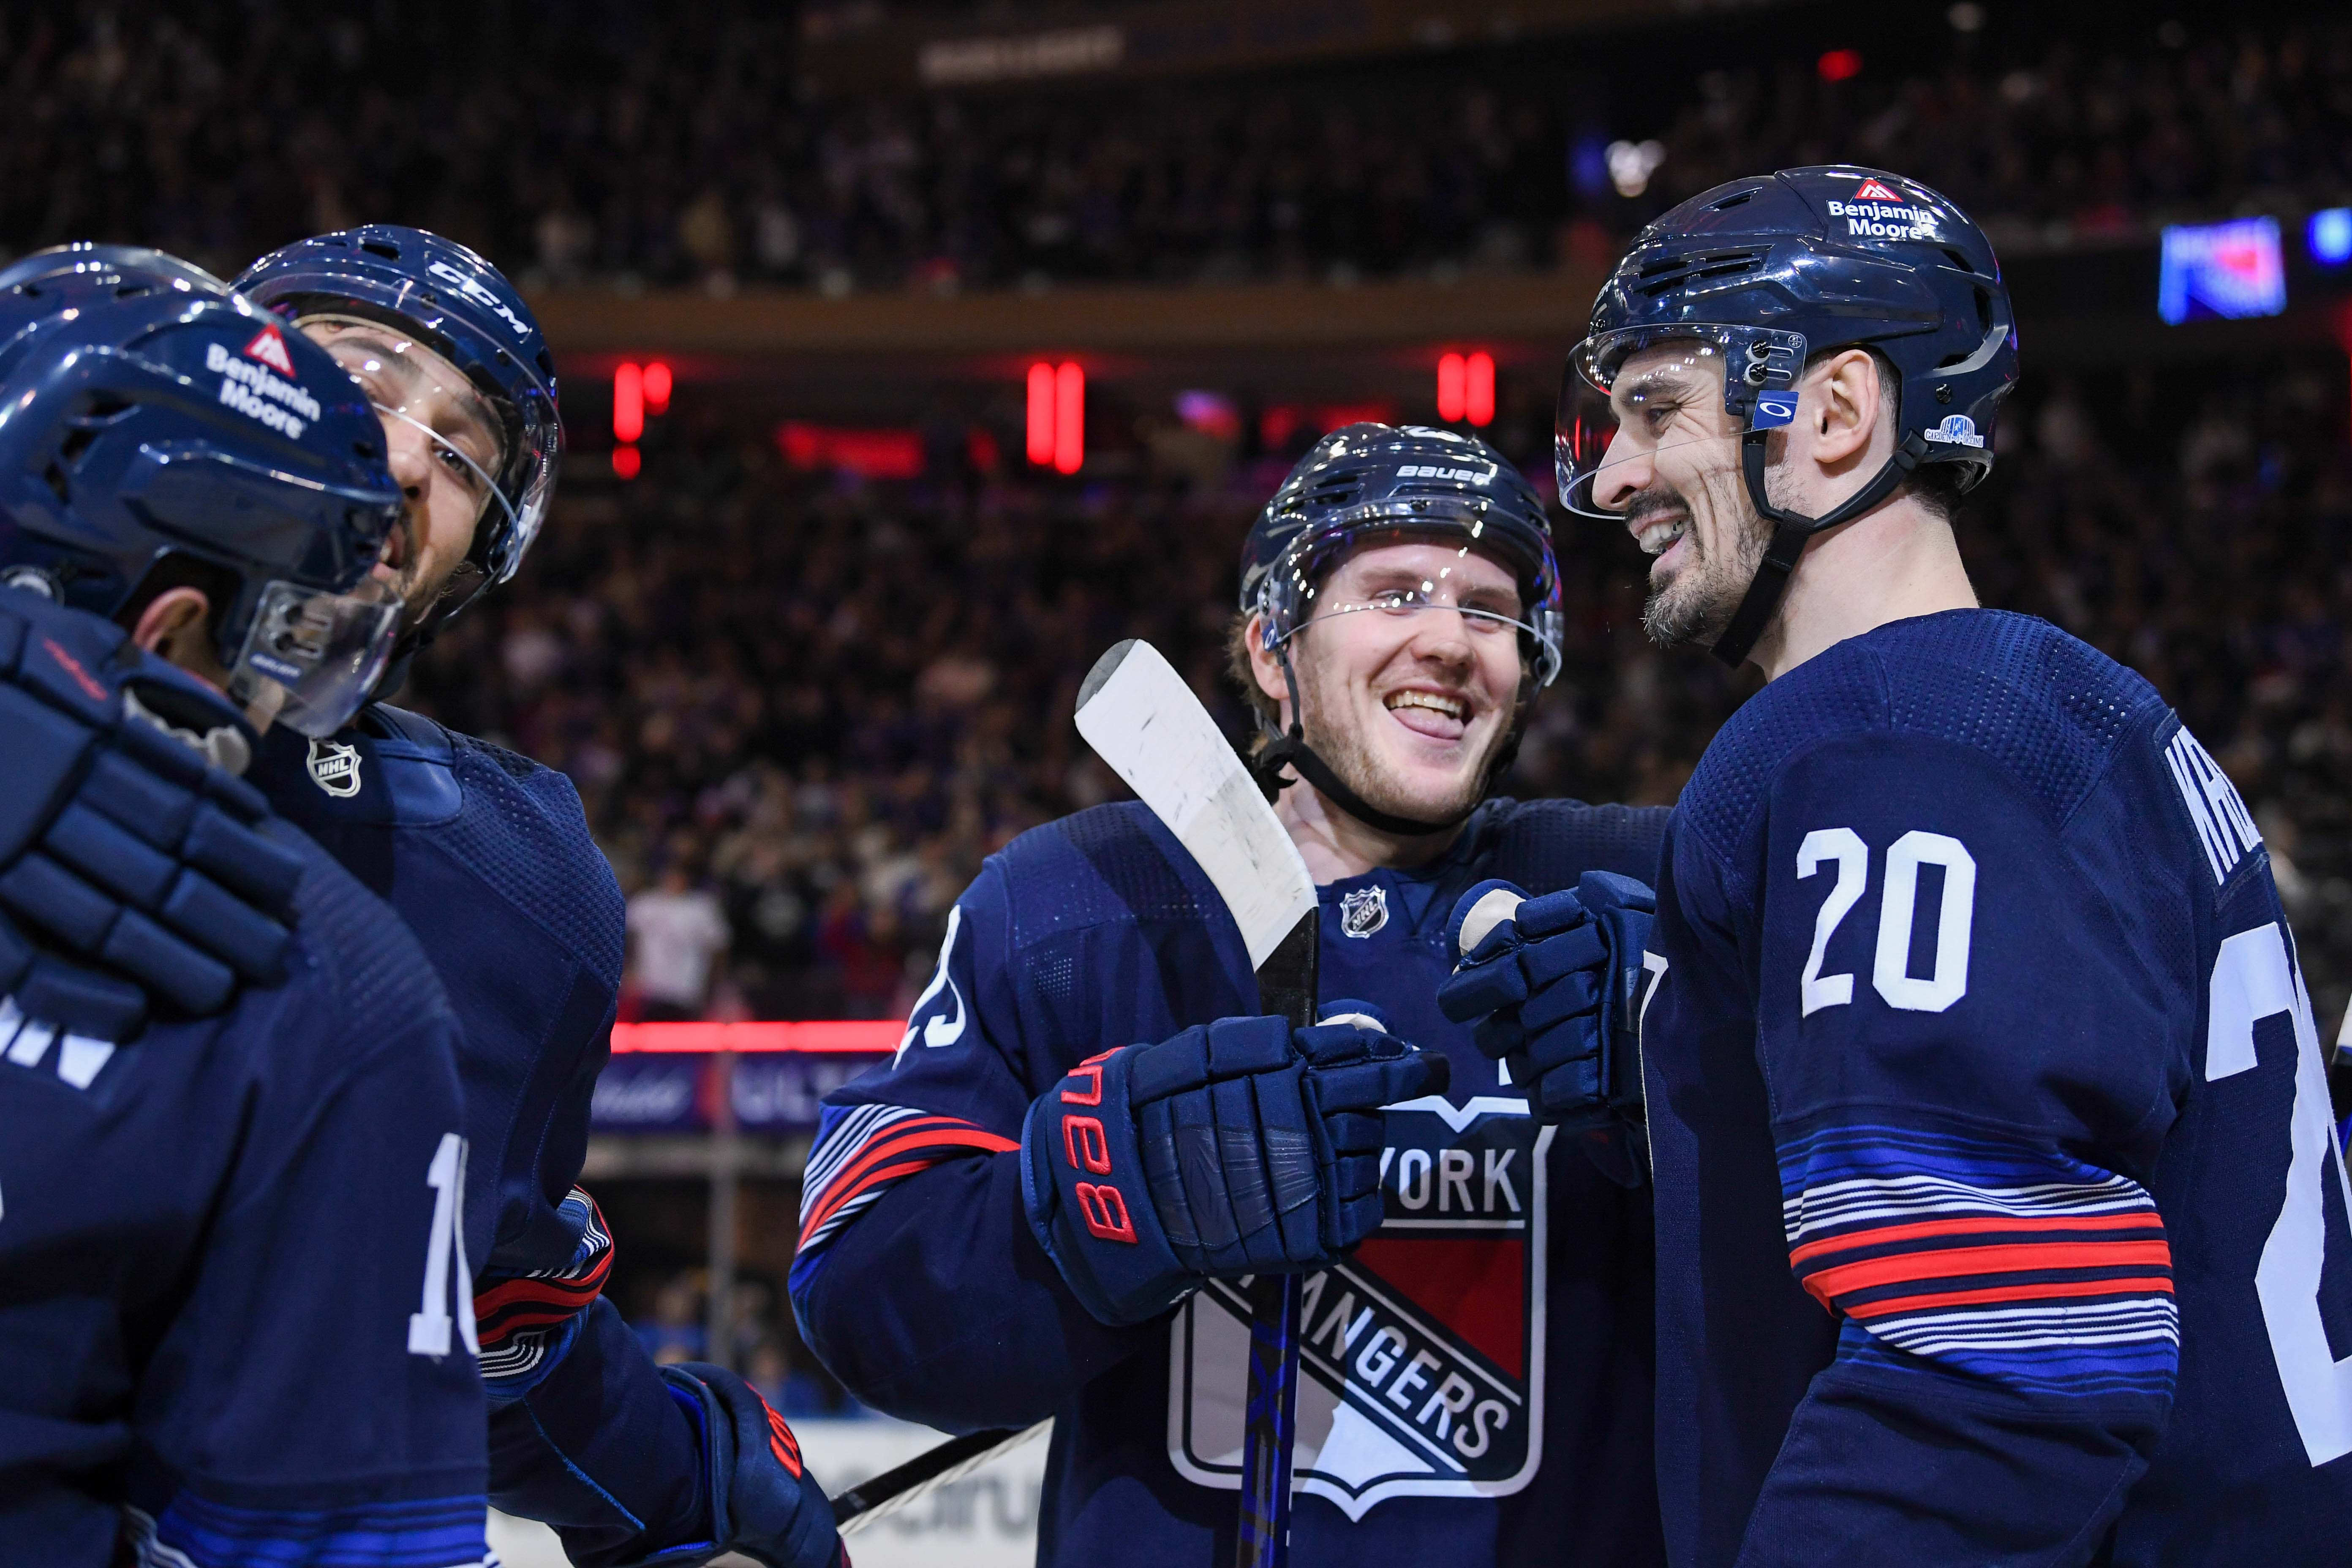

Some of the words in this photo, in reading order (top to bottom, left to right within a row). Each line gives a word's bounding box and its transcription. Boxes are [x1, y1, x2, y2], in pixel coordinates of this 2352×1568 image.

[1828, 201, 1936, 225] Benjamin
[1849, 218, 1923, 240] Moore
[428, 260, 528, 334] CCM
[206, 342, 321, 422] Benjamin
[219, 378, 303, 440] Moore
[1925, 430, 1951, 441] GARDEN
[1396, 465, 1491, 486] BAUER
[318, 758, 349, 776] NHL
[1352, 901, 1378, 930] NHL
[1796, 827, 1976, 1019] 20
[1061, 1046, 1139, 1244] BAU
[2206, 914, 2352, 1467] 2
[1238, 1270, 1509, 1459] ANGERS
